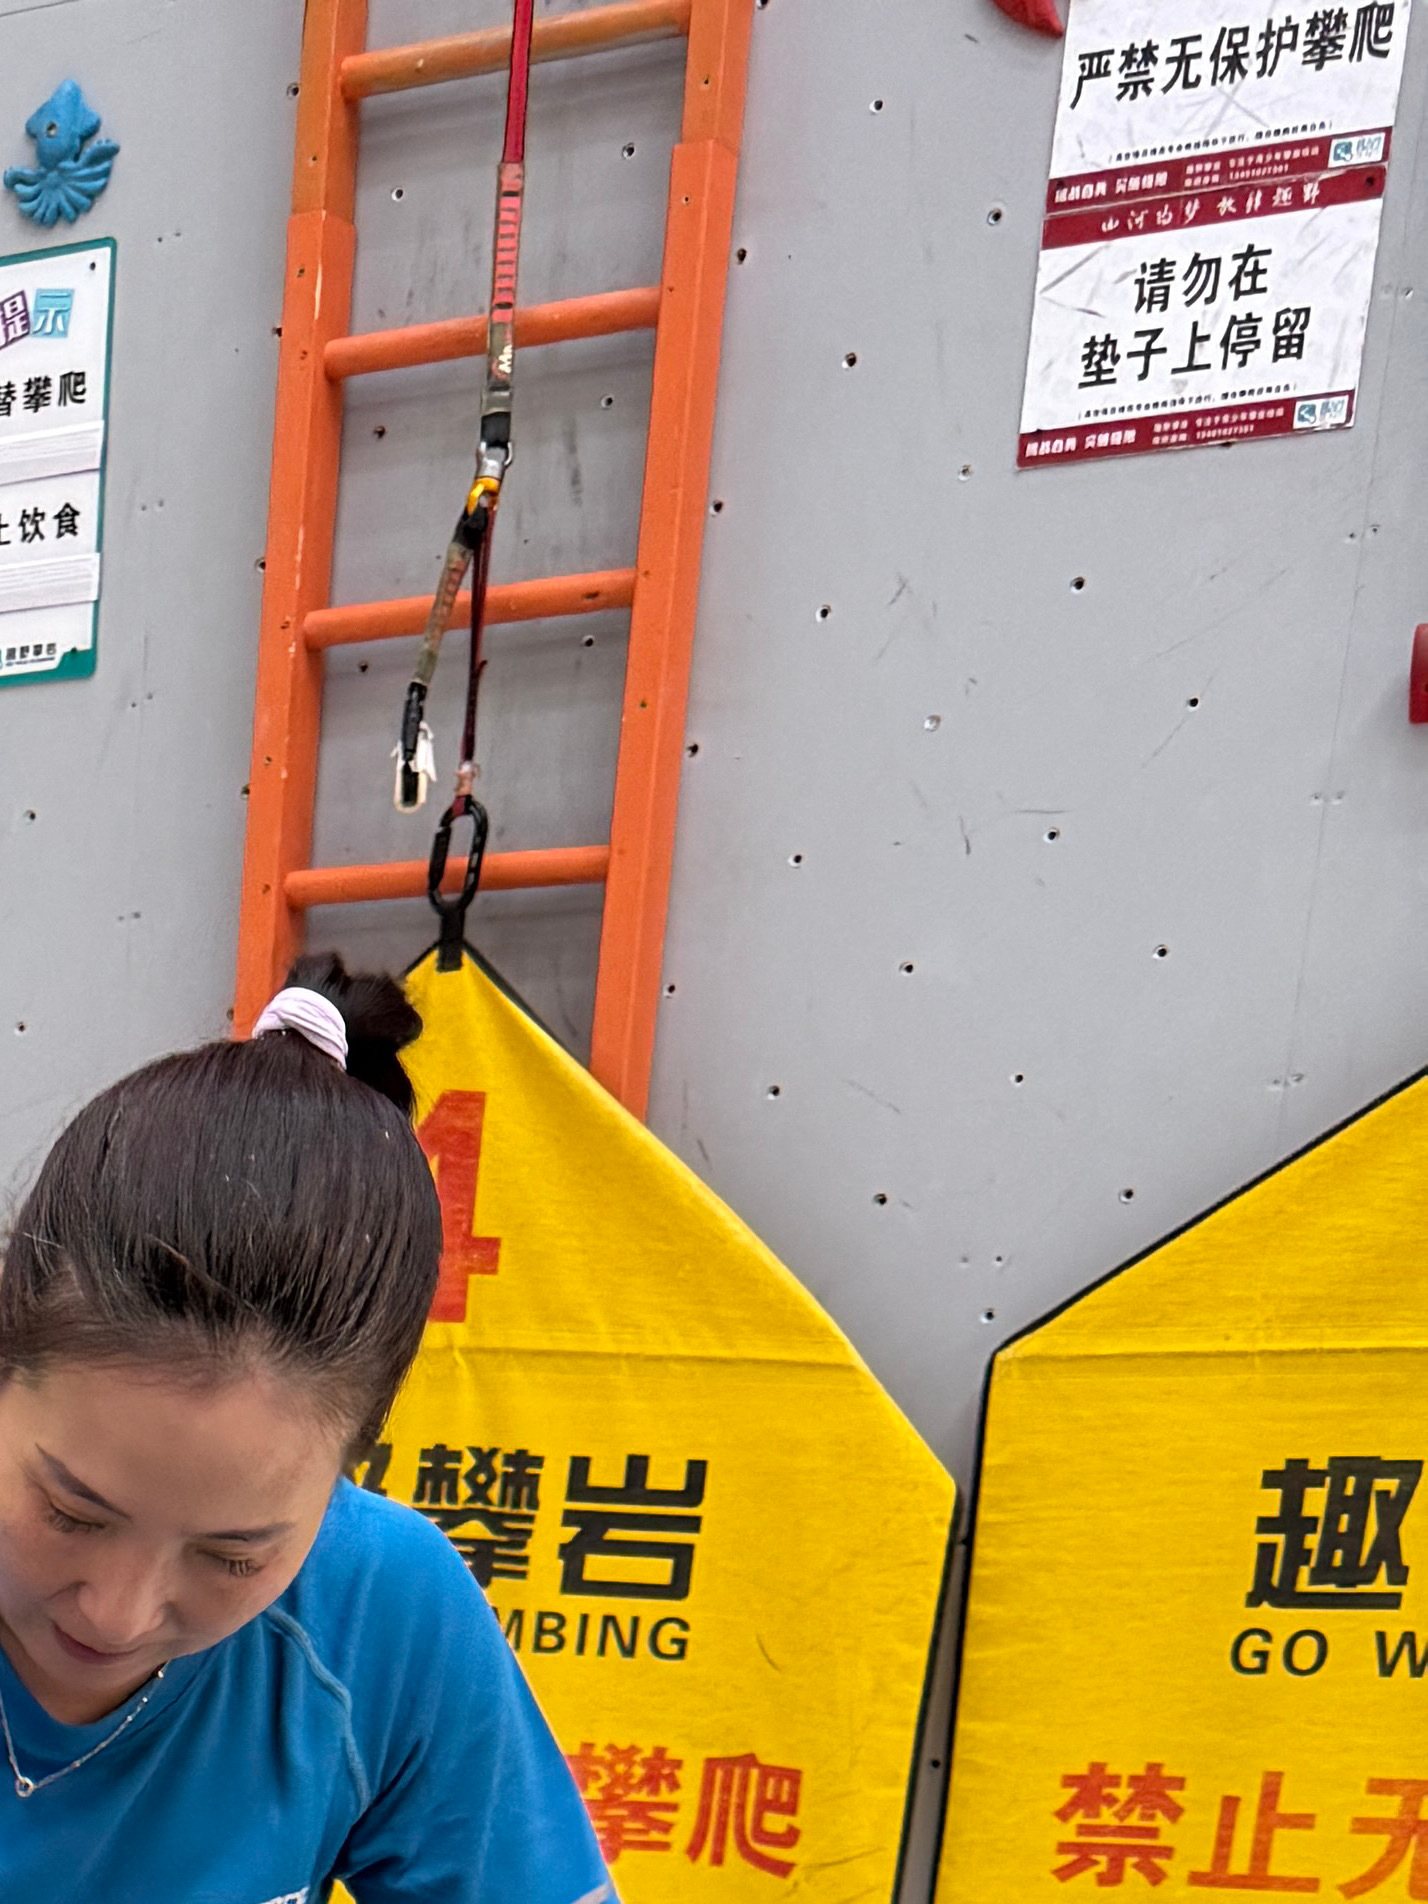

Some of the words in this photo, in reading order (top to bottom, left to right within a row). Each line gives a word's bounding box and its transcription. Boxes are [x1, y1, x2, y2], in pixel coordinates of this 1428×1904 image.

[1069, 0, 1400, 111] 严禁无保护攀爬
[1133, 243, 1273, 313] 请勿在
[1078, 306, 1312, 389] 垫子上停留
[1246, 1456, 1423, 1609] 趣
[1232, 1628, 1327, 1676] GO
[1052, 1761, 1428, 1900] 禁止无
